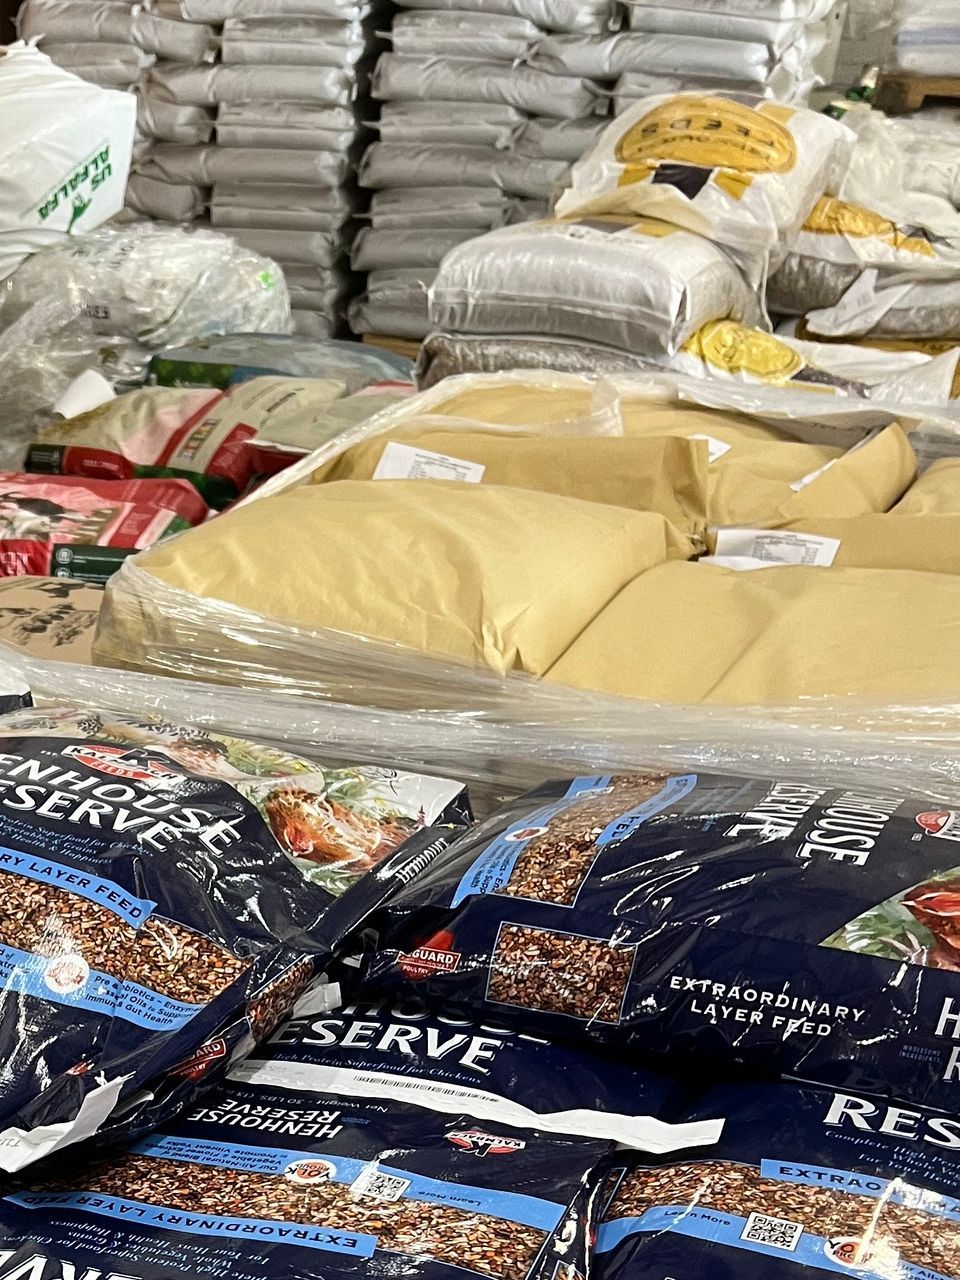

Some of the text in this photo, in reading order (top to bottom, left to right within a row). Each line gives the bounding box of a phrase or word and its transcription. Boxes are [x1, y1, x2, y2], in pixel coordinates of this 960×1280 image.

[90, 760, 136, 778] FEEDS
[37, 824, 89, 846] Superfood
[59, 847, 115, 866] Happiness
[28, 860, 93, 891] LAYER
[95, 883, 143, 919] FEED
[94, 974, 110, 986] Pre
[129, 995, 146, 1009] Oils
[669, 975, 866, 1022] EXTRAORDINARY
[124, 1002, 174, 1026] Gut Health
[690, 999, 832, 1037] LAYER FEED
[301, 1054, 482, 1085] Protein Superfood for Chickens
[217, 1098, 341, 1124] RESERVE
[317, 1098, 361, 1112] Weight
[187, 1107, 344, 1139] HENHOUSE
[451, 1131, 522, 1149] KALMBACH
[825, 1130, 927, 1160] Complete High
[858, 1153, 921, 1174] For Your
[892, 1153, 936, 1171] Whole
[286, 1166, 331, 1180] YOLK
[418, 1191, 482, 1207] Learn More
[77, 1194, 360, 1249] EXTRAORDINARY LAYER
[700, 1212, 732, 1226] More
[48, 1219, 170, 1249] Health Happiness
[78, 1239, 141, 1264] Superfood
[144, 1254, 191, 1274] Protein
[195, 1264, 228, 1278] High
